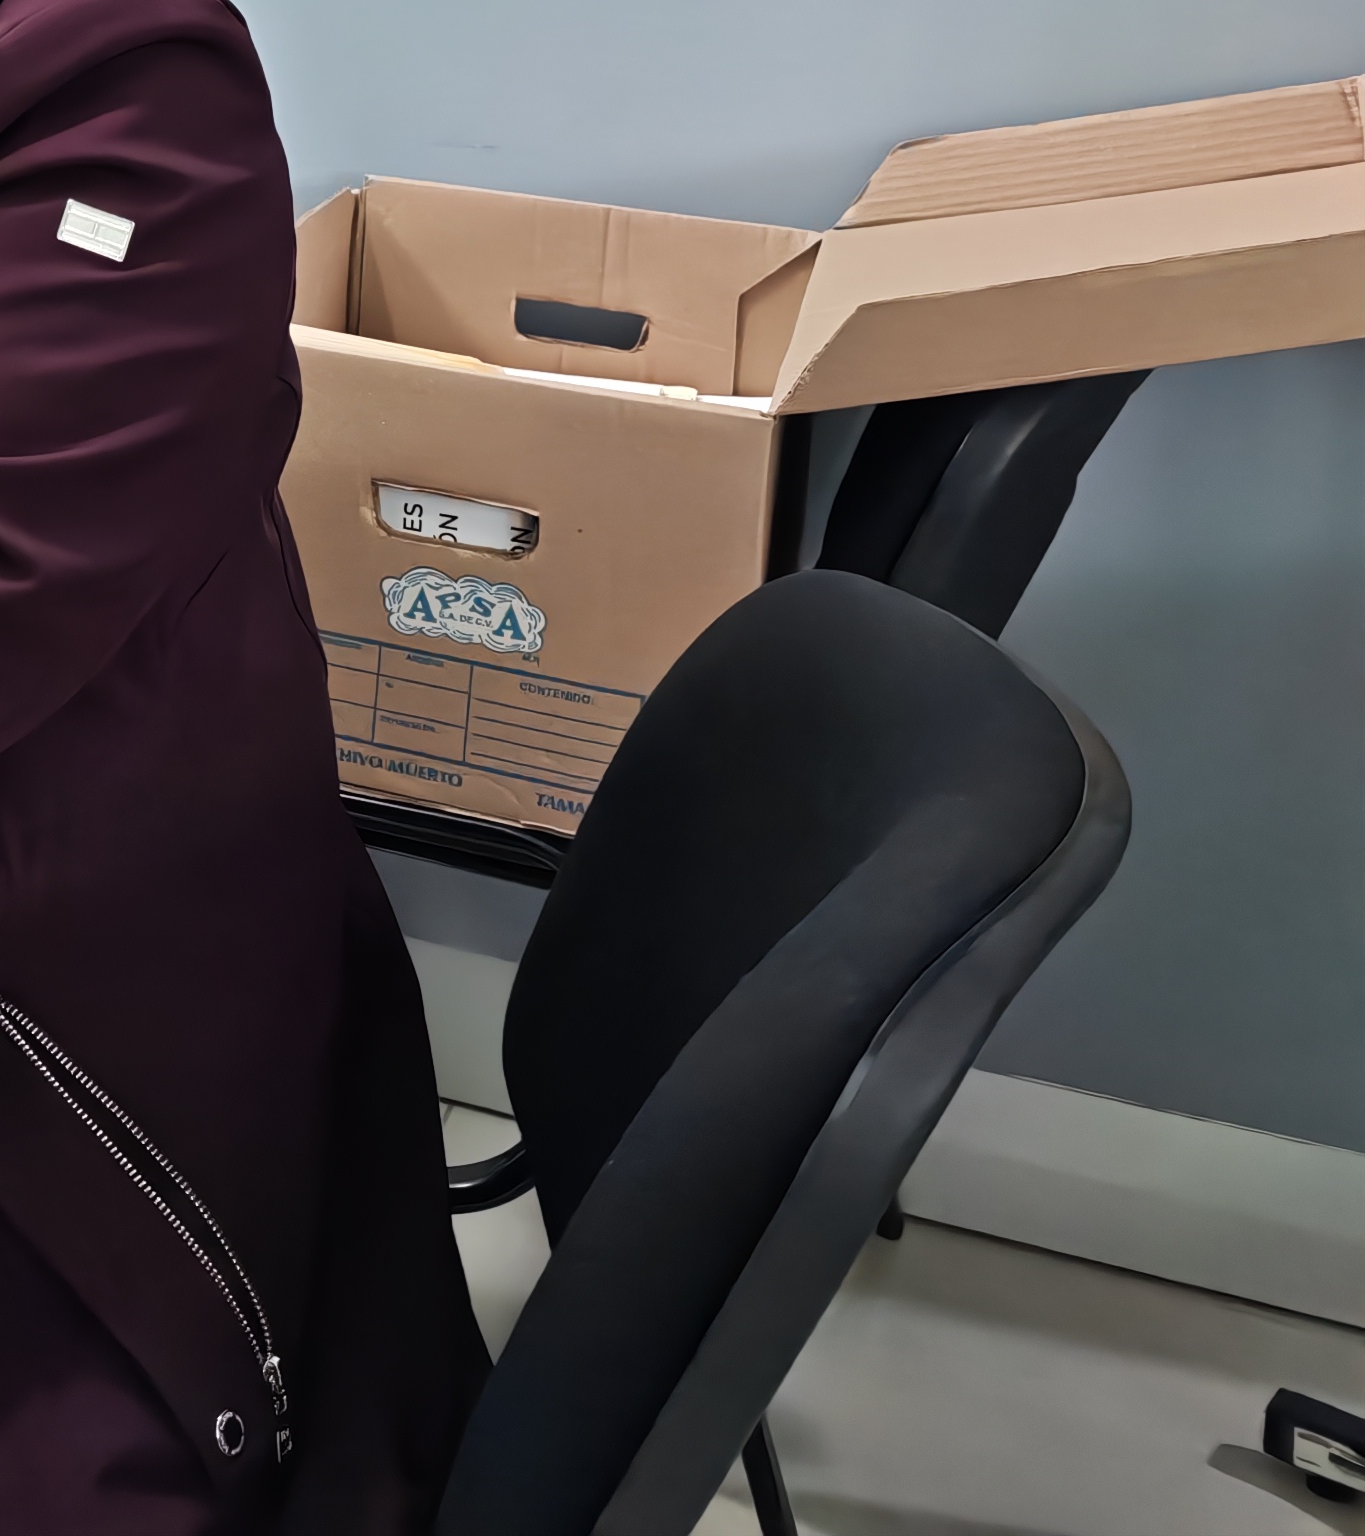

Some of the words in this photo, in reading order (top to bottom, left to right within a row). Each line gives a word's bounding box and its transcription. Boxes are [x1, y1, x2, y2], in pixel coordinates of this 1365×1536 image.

[403, 502, 423, 532] ES
[404, 586, 528, 641] APSA
[338, 748, 383, 768] HIVO
[389, 759, 463, 787] MUERTO
[535, 792, 585, 814] TAMA
